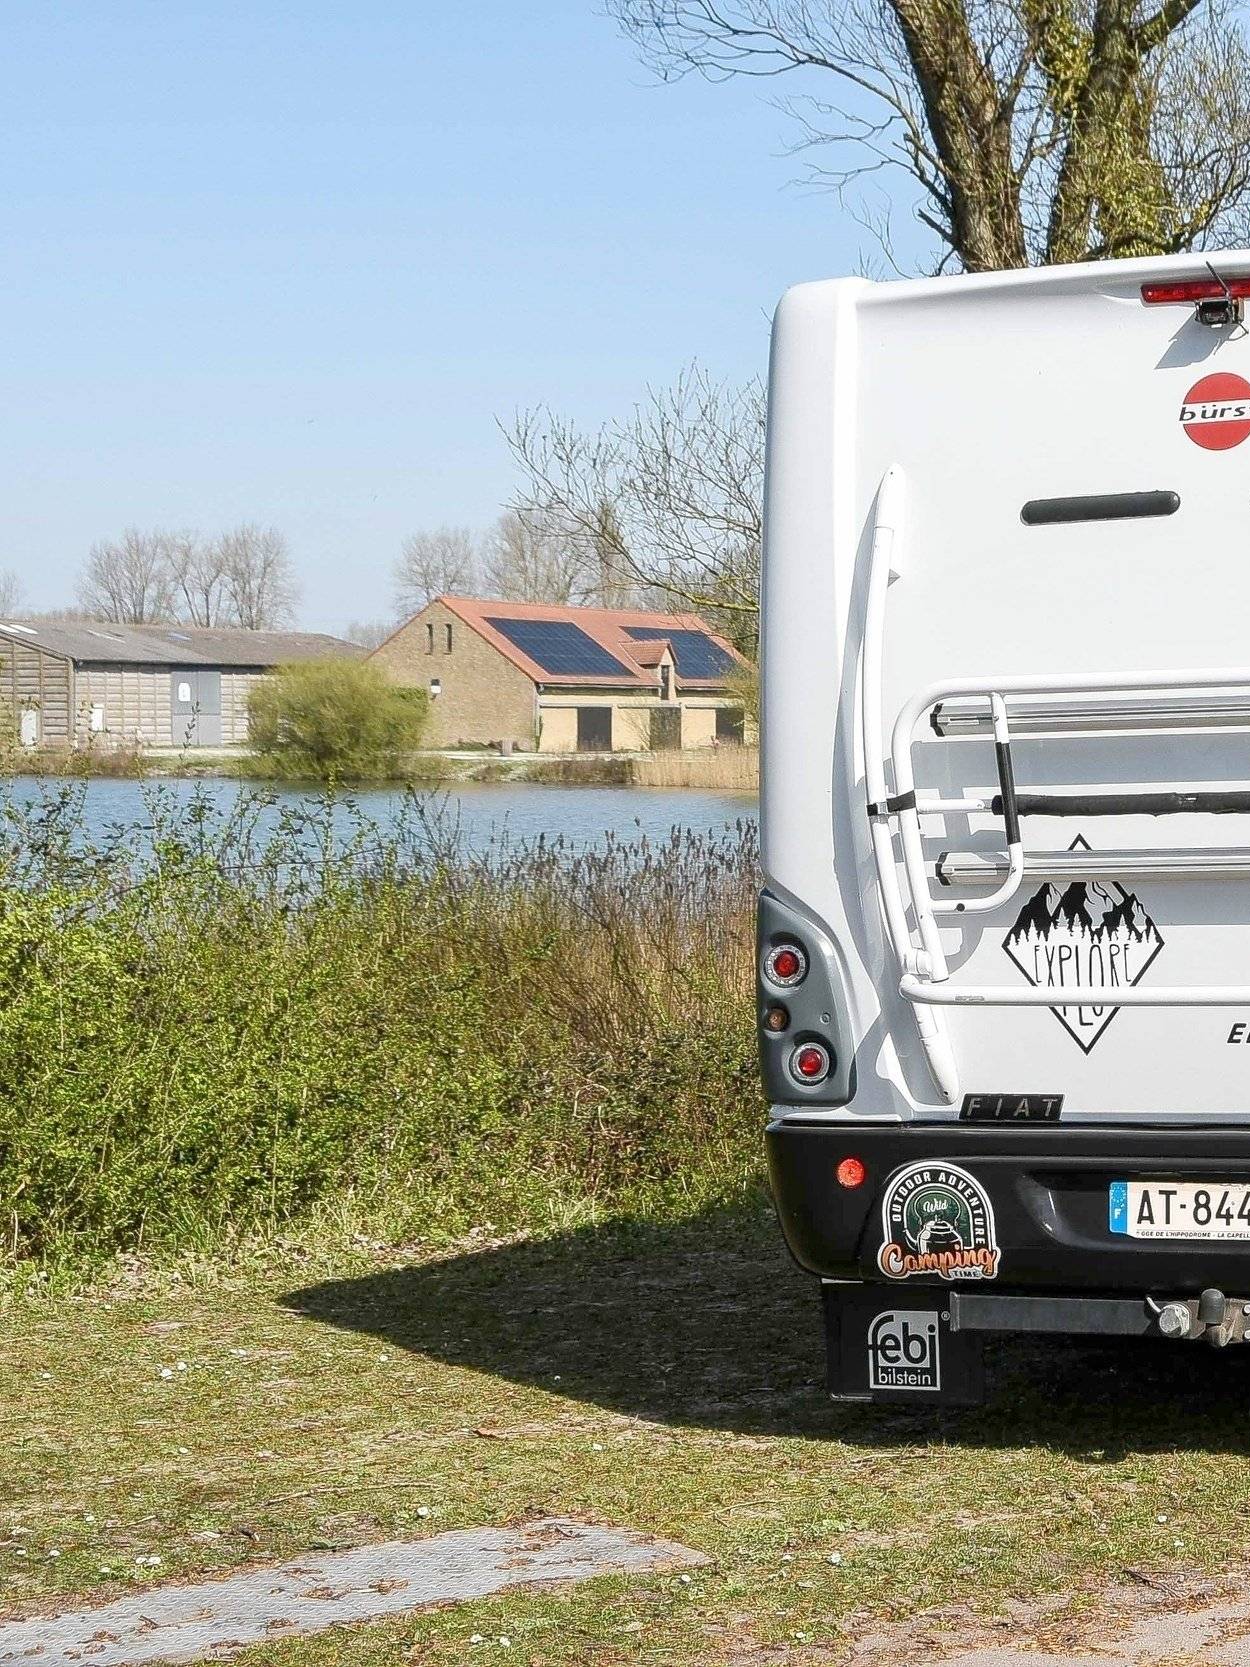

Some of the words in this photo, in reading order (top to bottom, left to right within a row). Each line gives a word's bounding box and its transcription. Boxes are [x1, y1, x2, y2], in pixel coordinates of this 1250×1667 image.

[966, 1096, 1059, 1117] FIAT
[892, 1171, 932, 1222] OUTDOOR
[938, 1172, 986, 1245] ADVENTURE
[1114, 1208, 1122, 1219] F
[882, 1243, 996, 1276] Camping
[868, 1314, 936, 1367] febi
[878, 1367, 931, 1385] bilstein
